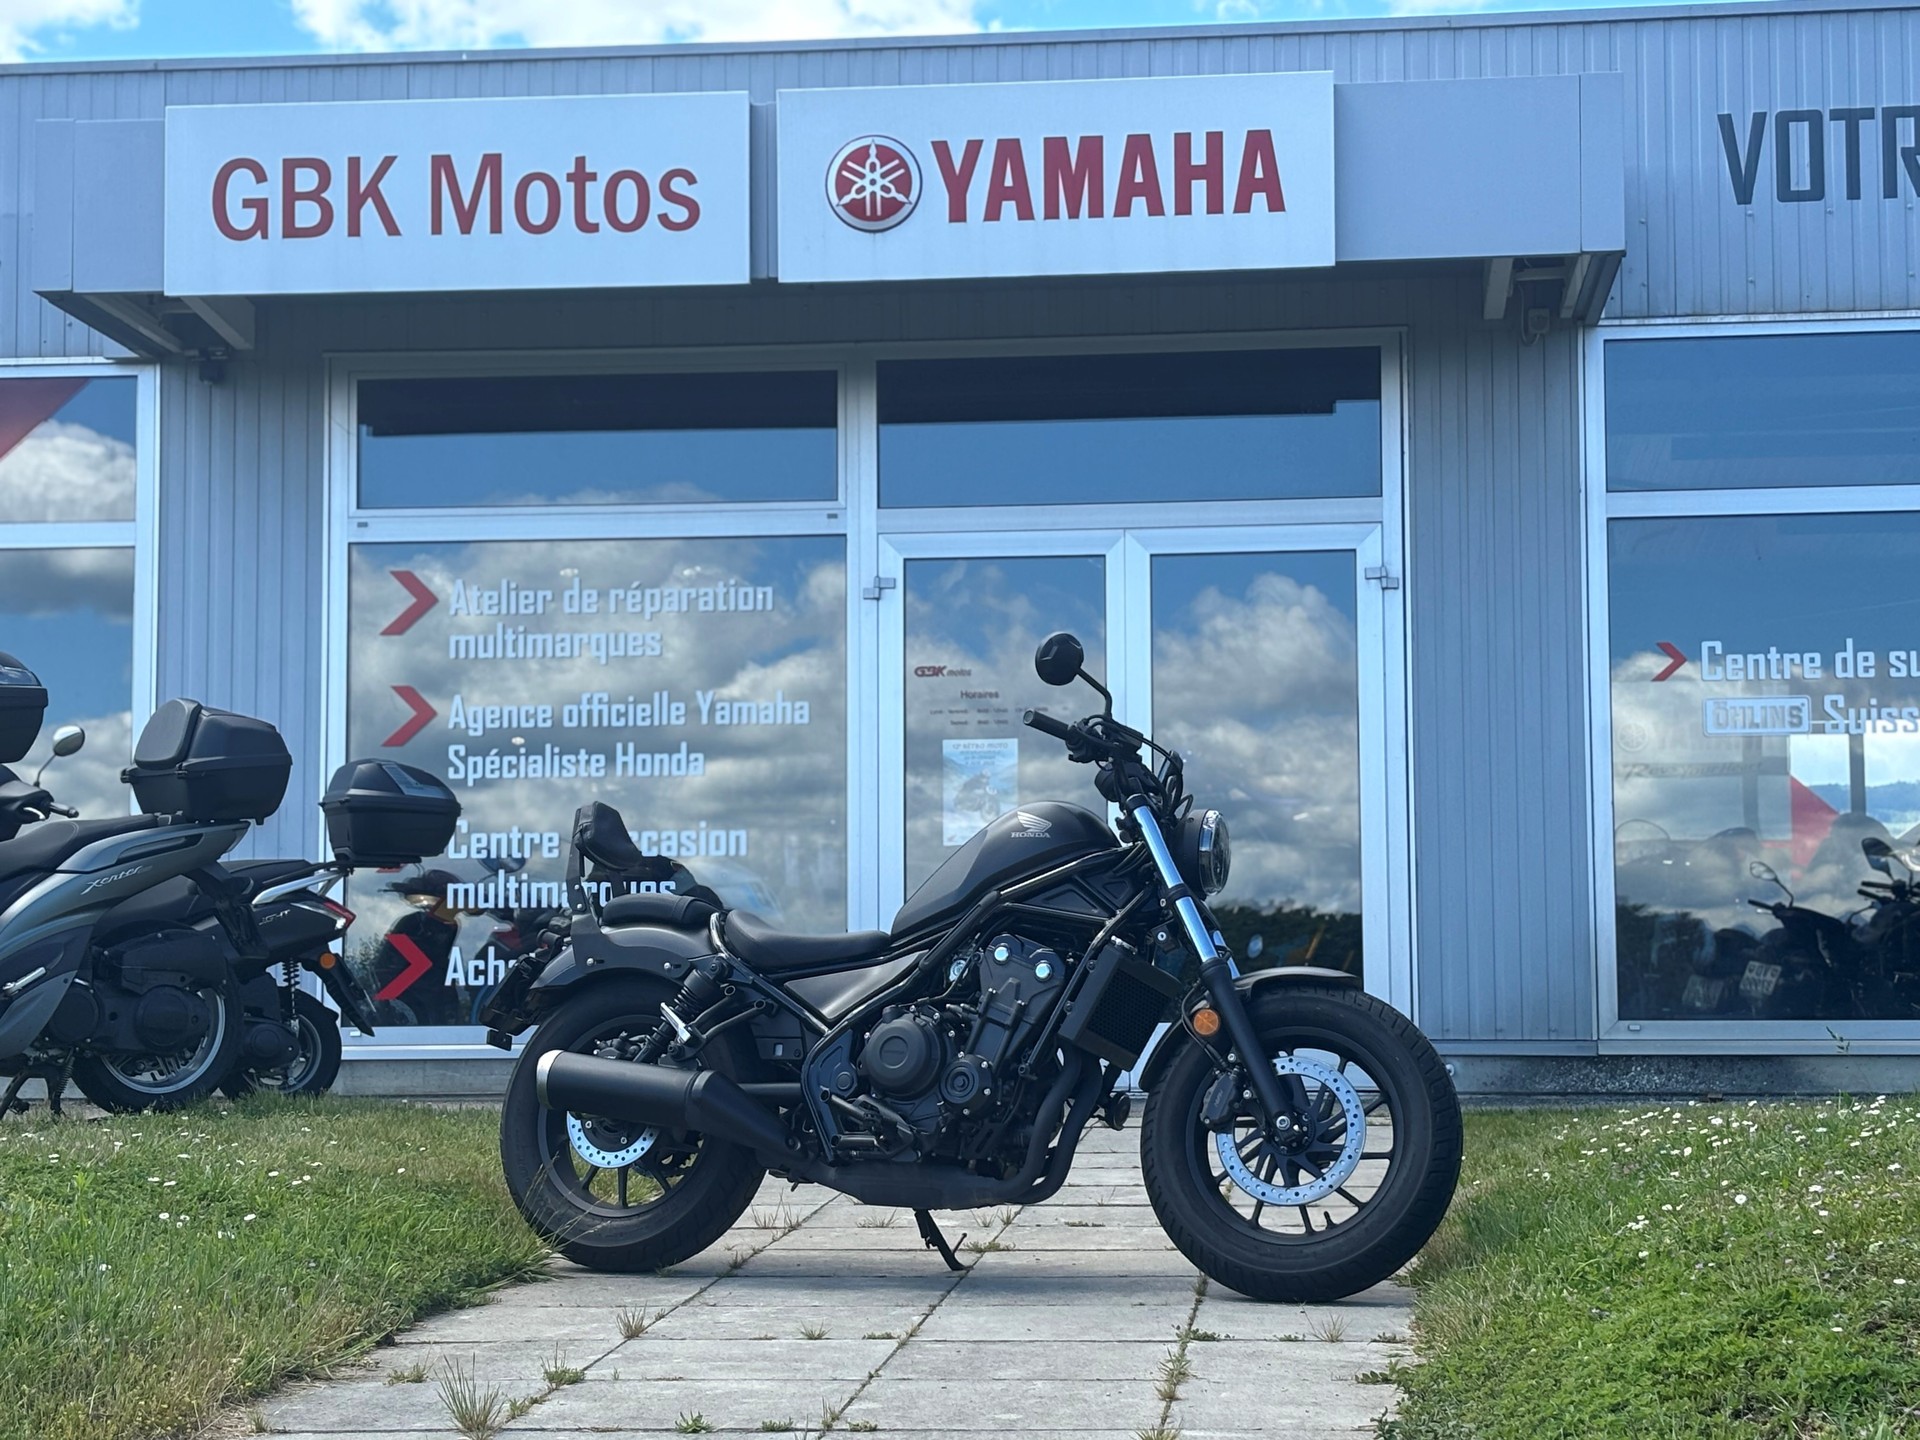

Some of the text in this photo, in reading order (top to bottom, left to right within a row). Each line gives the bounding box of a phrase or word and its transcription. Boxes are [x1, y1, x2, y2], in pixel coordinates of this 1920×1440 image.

[931, 129, 1286, 223] YAMAHA
[1717, 105, 1920, 205] VOTR
[212, 153, 701, 241] GBK Motos
[449, 577, 773, 620] Atelier de réparation
[449, 623, 661, 664] multimarques
[1701, 639, 1822, 681] Centre
[1834, 637, 1876, 678] de
[914, 666, 946, 677] GBK
[448, 690, 810, 737] Agence officielle Yamaha
[960, 690, 999, 700] Horaires
[1712, 700, 1804, 730] ÖHLINS
[448, 741, 705, 786] Spécialiste Honda
[448, 819, 560, 859] Centre
[444, 946, 526, 986] Ach
